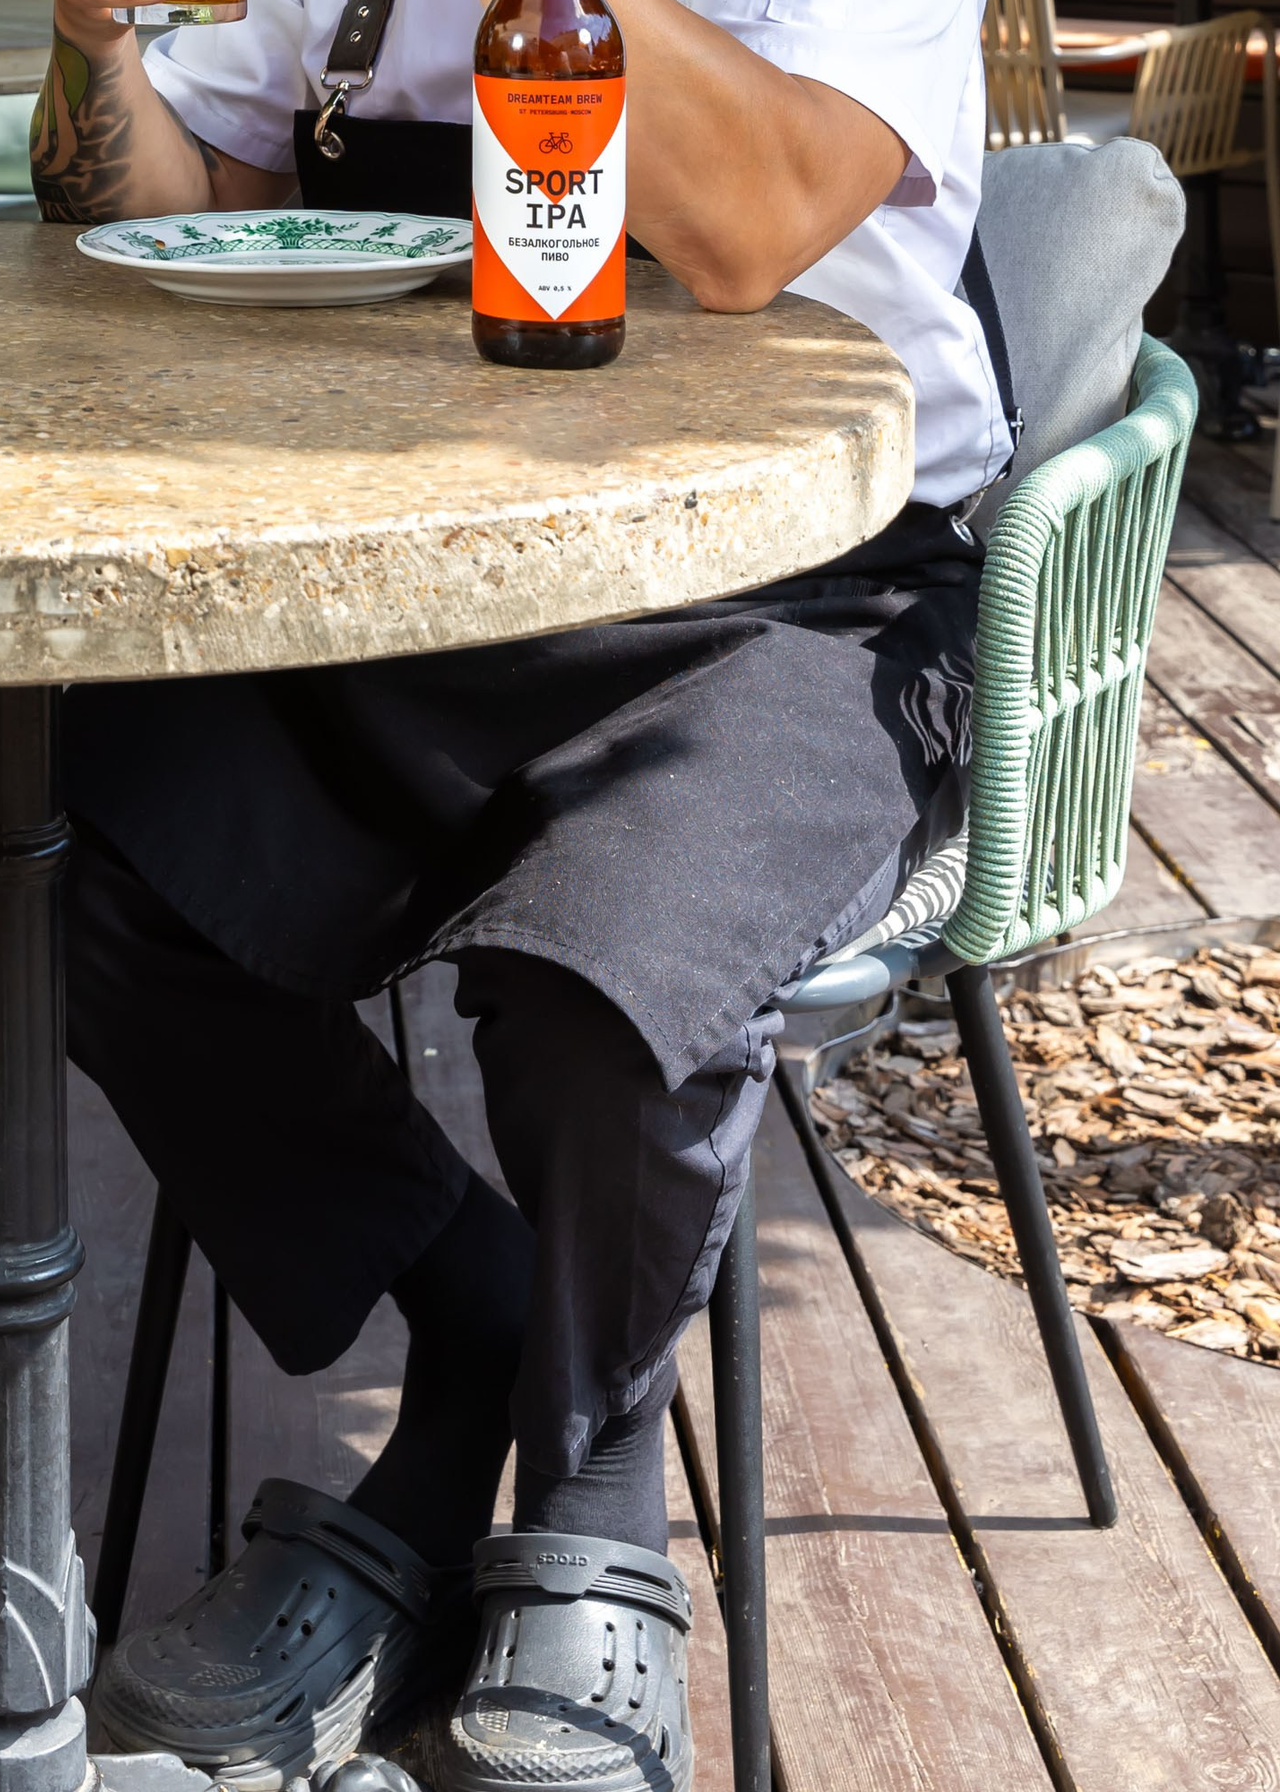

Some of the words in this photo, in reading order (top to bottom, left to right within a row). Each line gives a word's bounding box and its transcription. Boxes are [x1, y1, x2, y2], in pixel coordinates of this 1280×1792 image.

[507, 93, 572, 104] DREAMTEAM
[577, 94, 602, 104] BREW
[505, 168, 603, 196] SPORT
[526, 203, 586, 229] IPA
[508, 236, 600, 248] БЕЗАЛКОГОЛЬНОЕ
[541, 252, 569, 261] ПИВО
[536, 1553, 590, 1567] crocs
